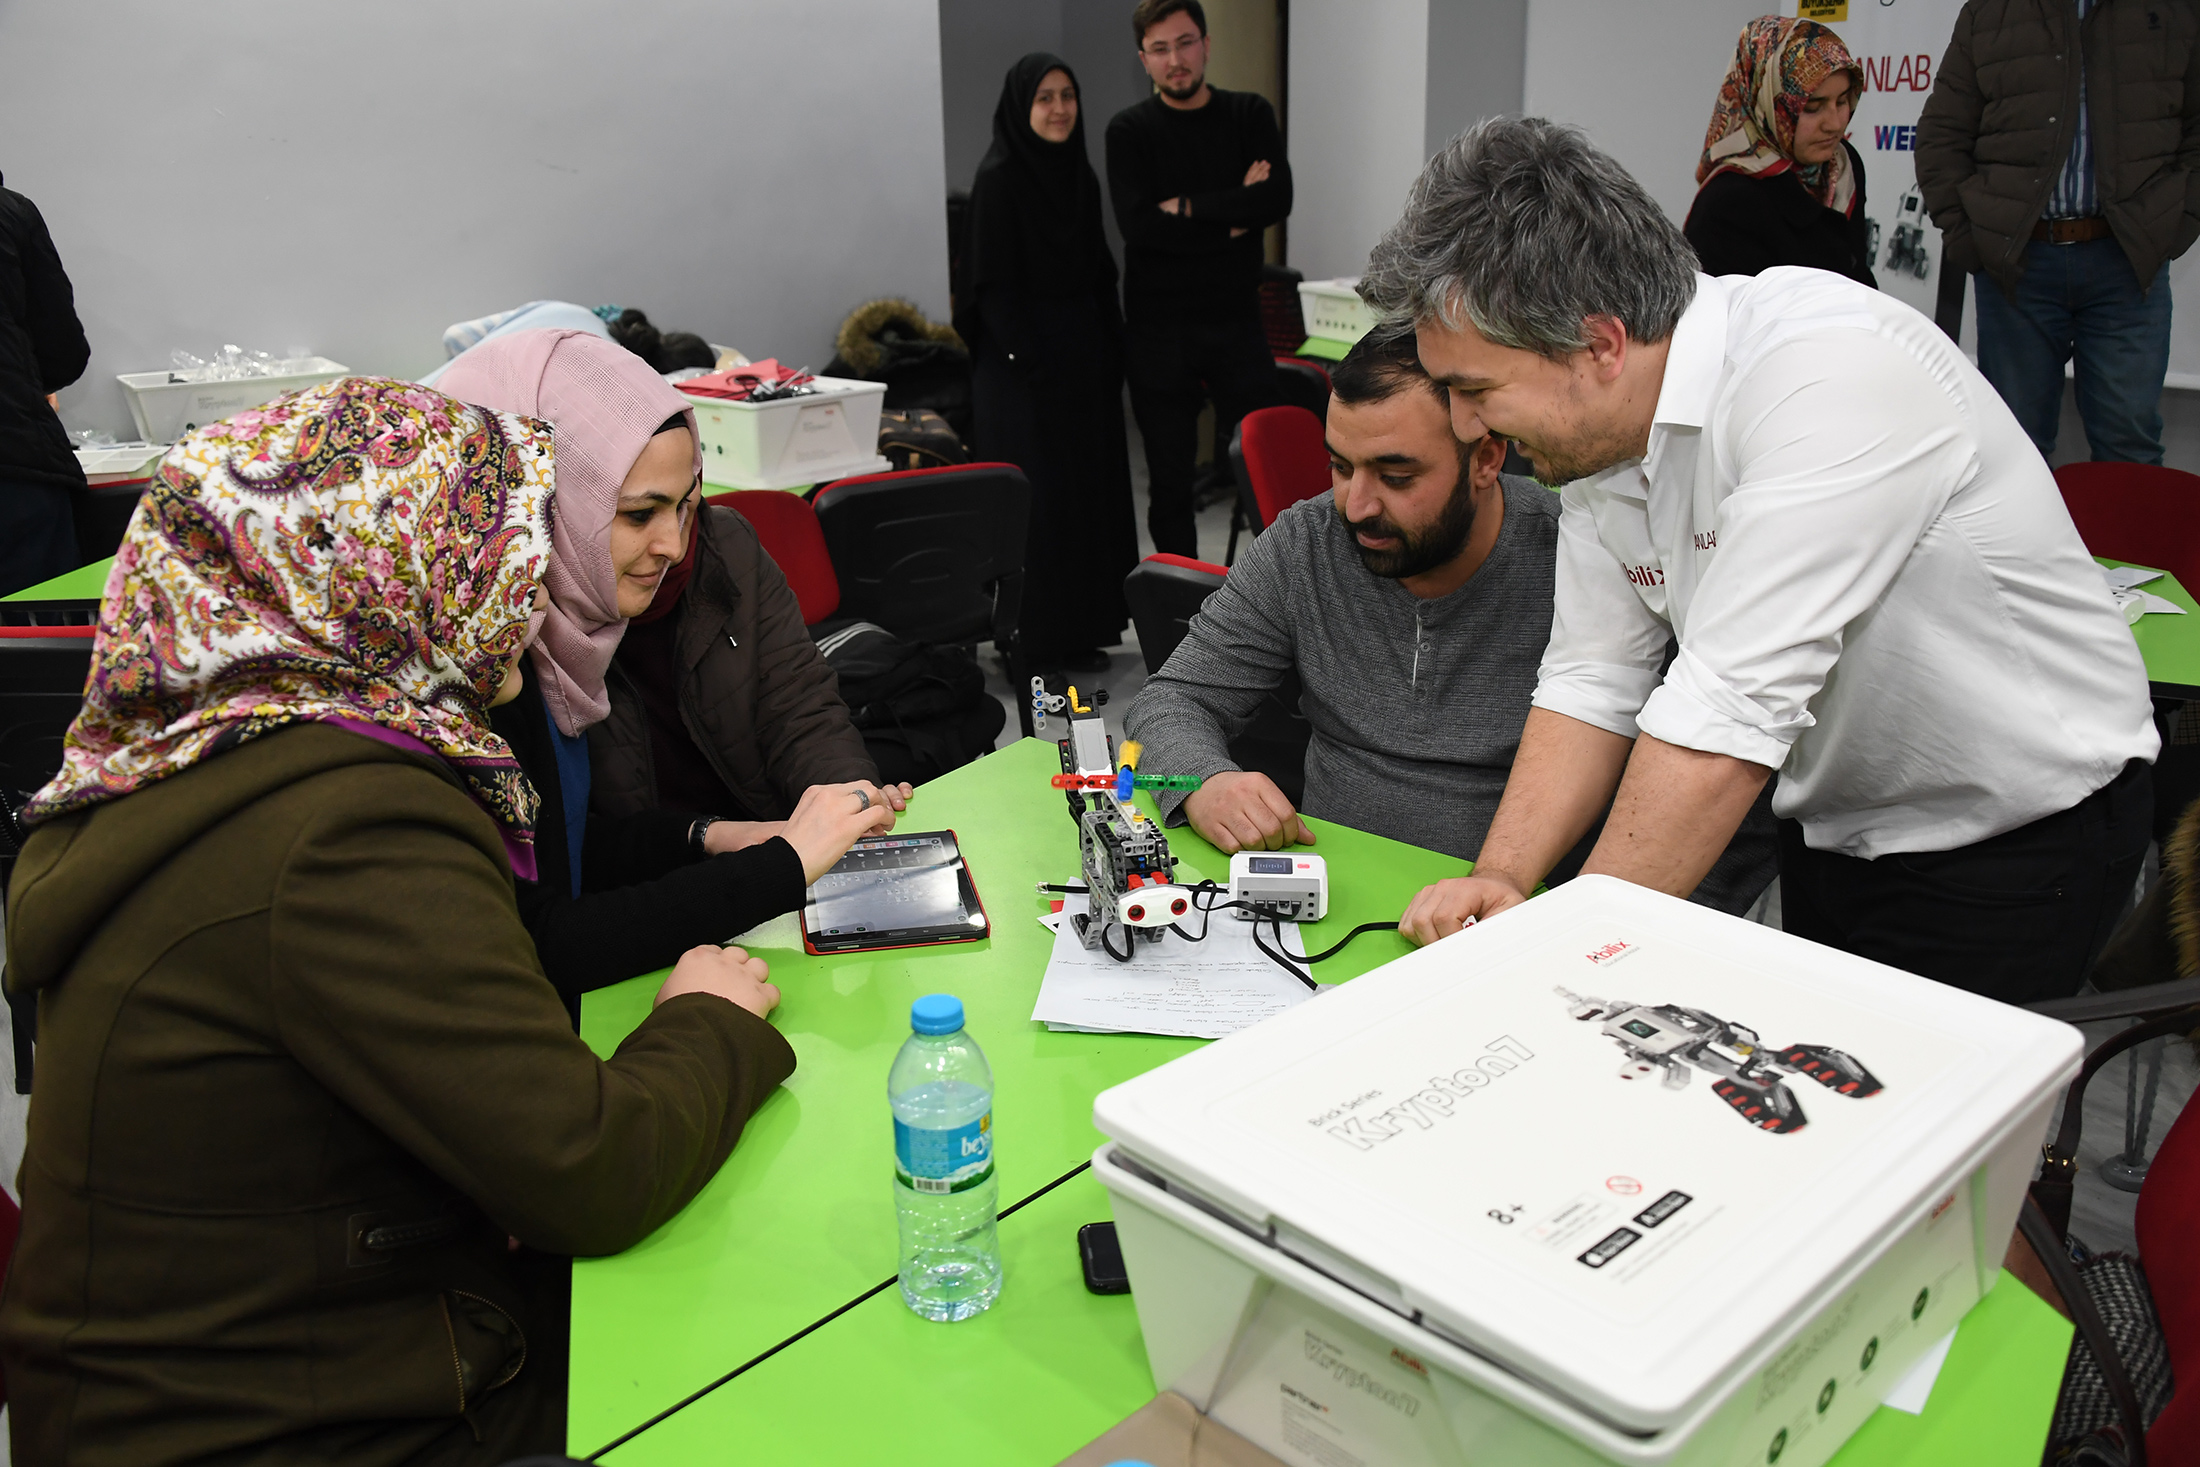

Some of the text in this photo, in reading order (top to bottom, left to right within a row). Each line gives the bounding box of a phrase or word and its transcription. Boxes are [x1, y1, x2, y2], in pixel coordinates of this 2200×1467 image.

[1586, 941, 1632, 964] Abilix
[1326, 1034, 1535, 1151] Krypton7
[1487, 1203, 1526, 1225] 8+
